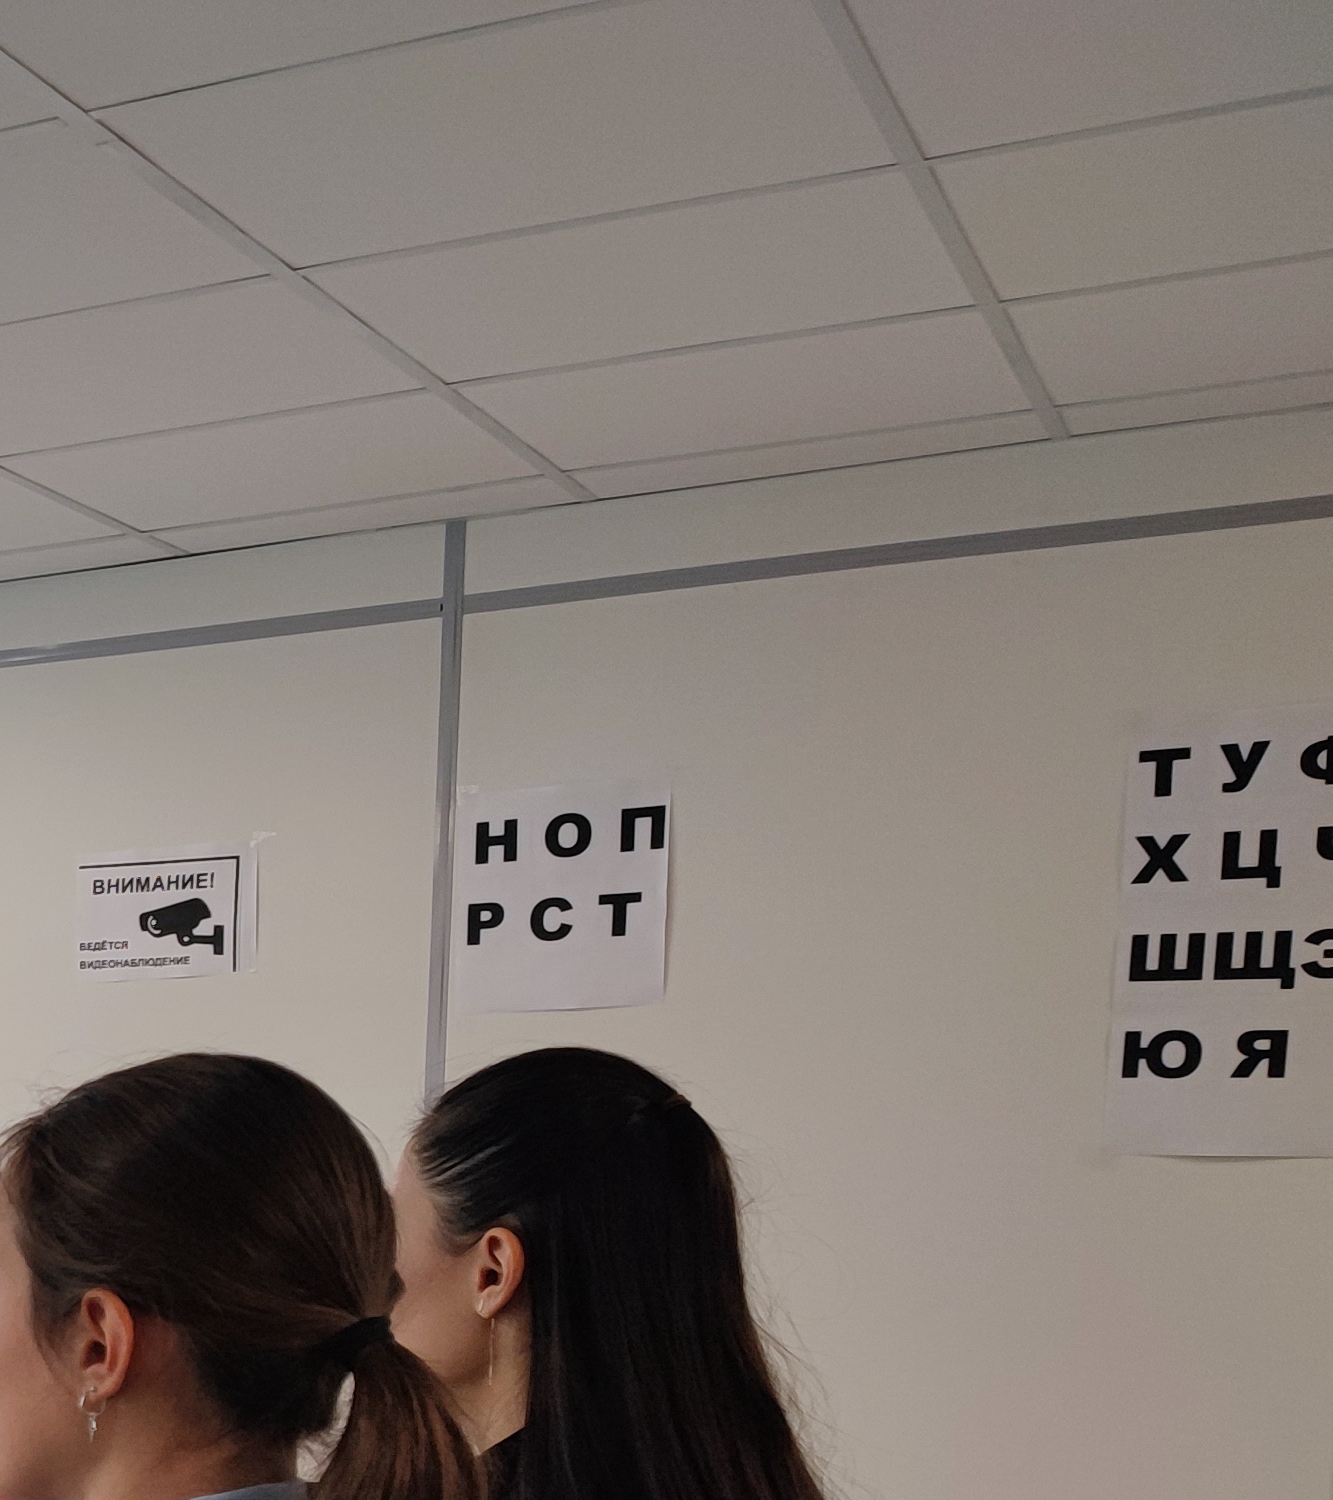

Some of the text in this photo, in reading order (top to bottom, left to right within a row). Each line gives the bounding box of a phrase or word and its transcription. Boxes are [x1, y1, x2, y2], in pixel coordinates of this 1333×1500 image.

[1139, 747, 1192, 797] Т
[1219, 740, 1272, 793] У
[475, 805, 666, 865] Н О П
[1130, 833, 1191, 884] Х
[1221, 829, 1282, 888] Ц
[92, 872, 215, 895] ВНИМАНИЕ!
[467, 891, 642, 946] Р С Т
[79, 940, 129, 952] ВЕДЁТСЯ
[79, 956, 191, 970] ВИДЕОНАБЛЮДЕНИЕ
[1121, 1030, 1290, 1079] Ю Я
